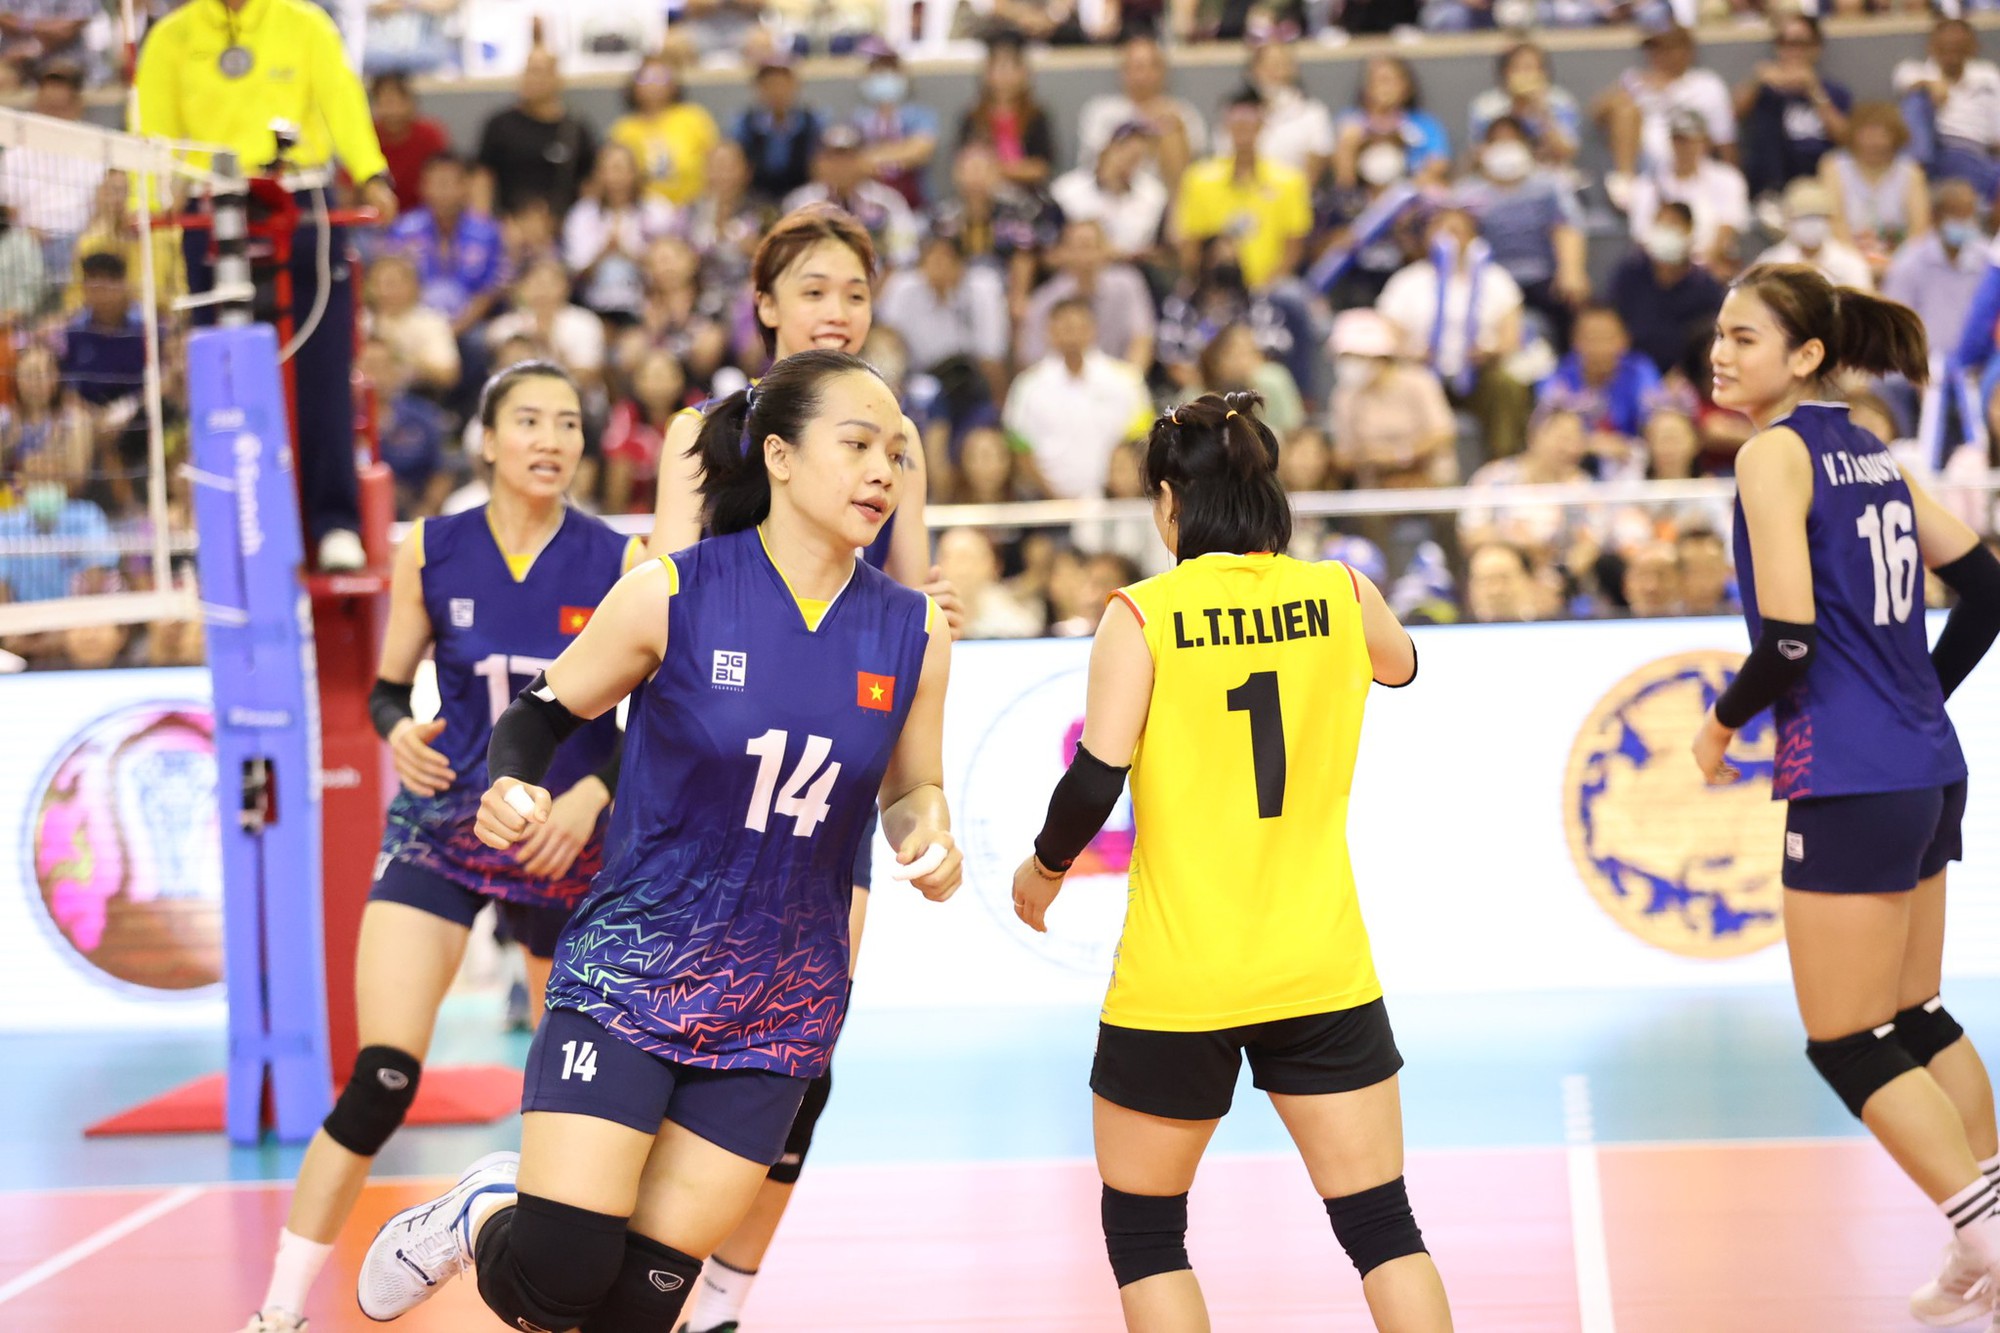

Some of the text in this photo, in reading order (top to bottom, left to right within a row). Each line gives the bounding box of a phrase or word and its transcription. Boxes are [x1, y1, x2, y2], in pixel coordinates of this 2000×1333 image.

[1856, 500, 1918, 626] 16
[1173, 598, 1330, 649] L.T.T.LIEN
[745, 728, 842, 838] 14
[1226, 671, 1286, 819] 1
[561, 1040, 598, 1082] 14
